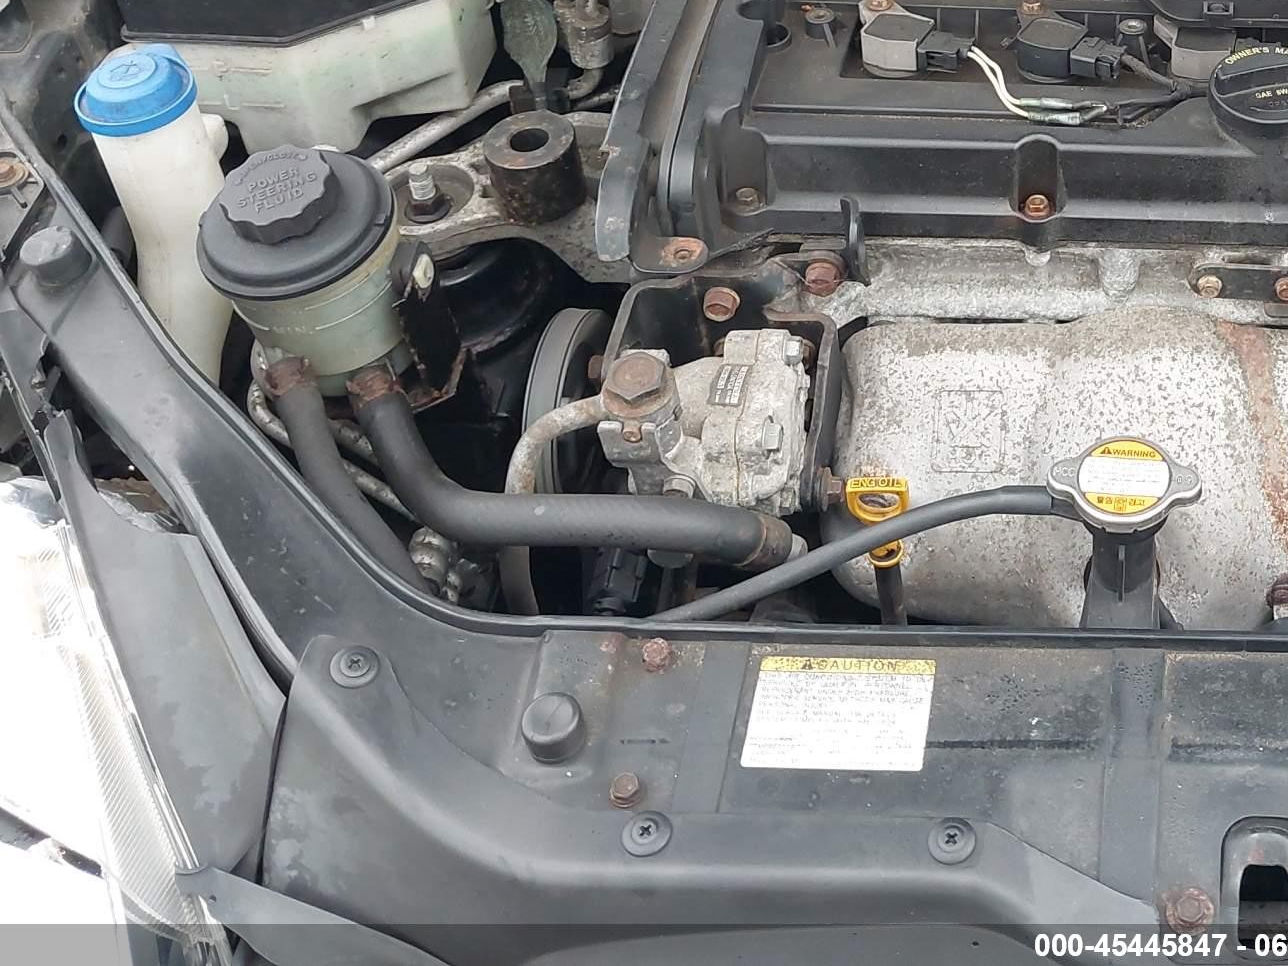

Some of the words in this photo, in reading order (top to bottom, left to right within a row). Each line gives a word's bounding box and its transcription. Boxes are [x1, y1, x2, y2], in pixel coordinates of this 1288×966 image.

[1224, 46, 1270, 65] OWNER'S
[247, 167, 299, 193] POWER
[236, 172, 318, 209] STEERING
[254, 190, 304, 214] FLUID
[1112, 448, 1157, 458] WARNING
[851, 477, 876, 488] ENG
[878, 477, 902, 488] OIL
[816, 659, 899, 673] CAUTION
